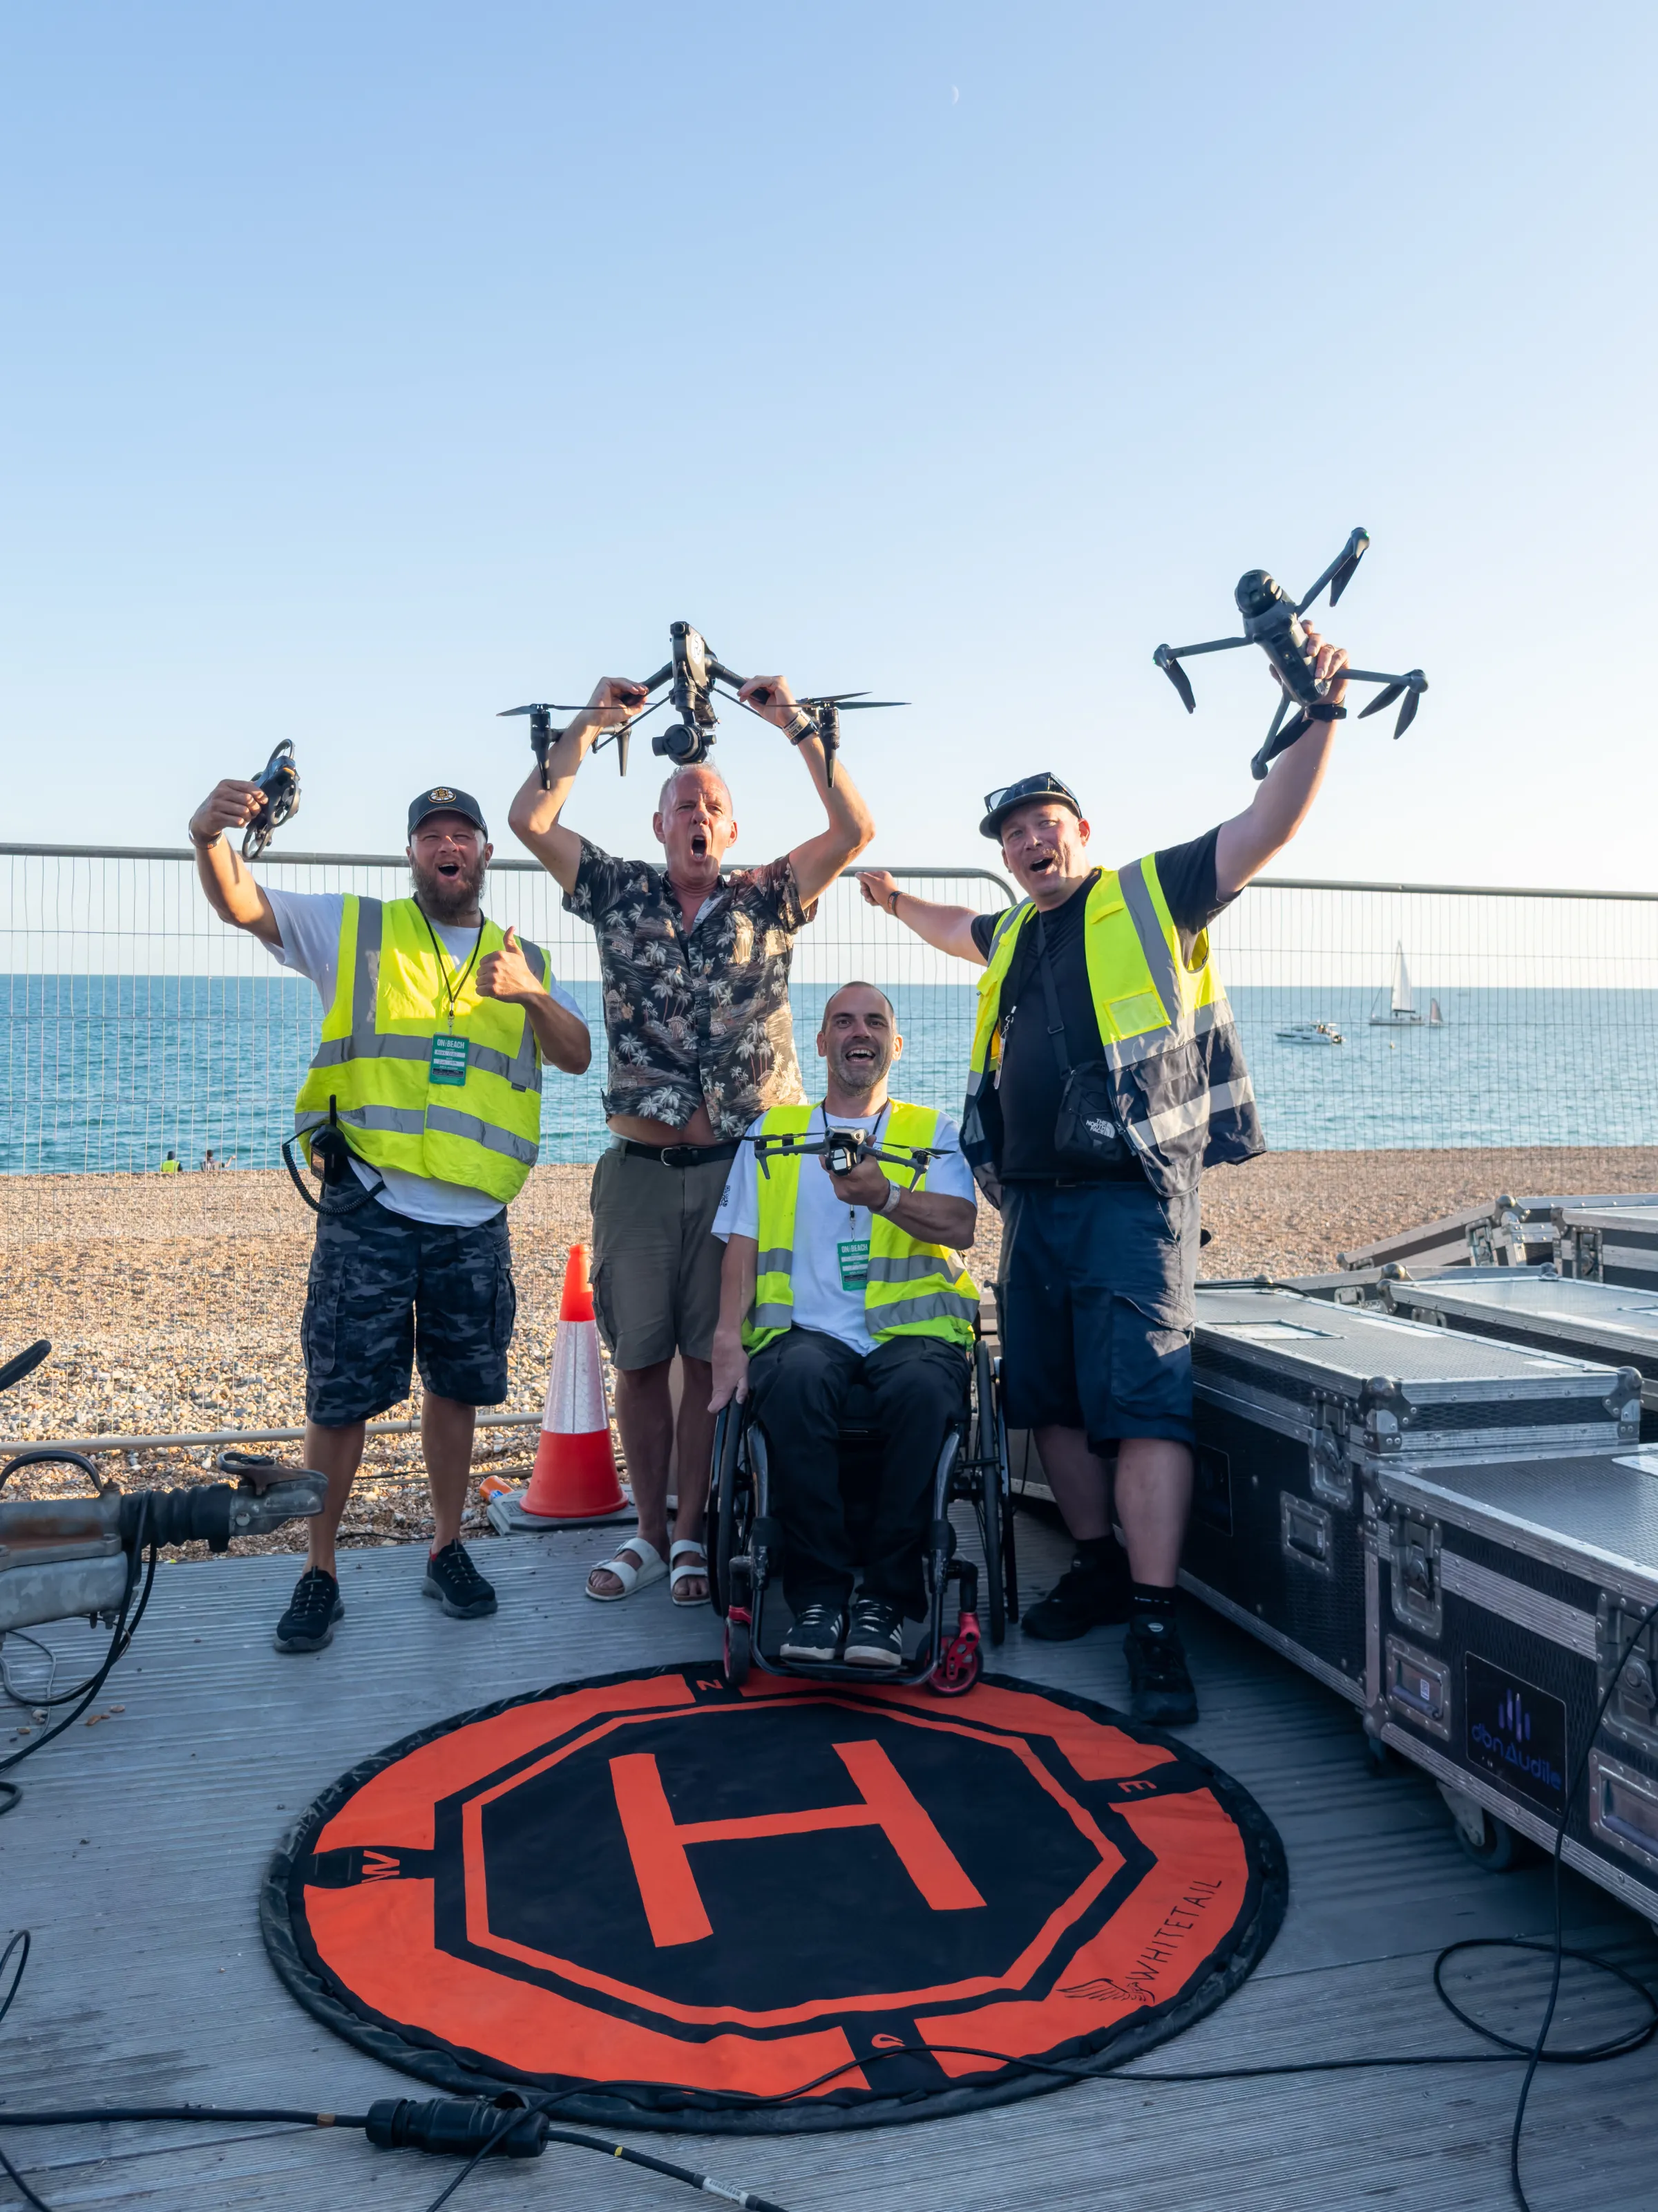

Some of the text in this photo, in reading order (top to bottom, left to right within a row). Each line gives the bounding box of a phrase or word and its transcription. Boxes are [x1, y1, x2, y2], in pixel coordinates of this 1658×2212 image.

[437, 1039, 445, 1047] ON
[447, 1039, 465, 1049] BEACH
[1086, 1119, 1106, 1131] NORTH
[1096, 1118, 1107, 1126] THE
[1089, 1126, 1105, 1135] FACE
[850, 1244, 868, 1252] BEACH
[696, 1679, 723, 1691] N
[1117, 1780, 1157, 1793] E
[609, 1739, 988, 1948] H
[361, 1850, 401, 1884] W
[1125, 1880, 1222, 1981] WHITETAIL
